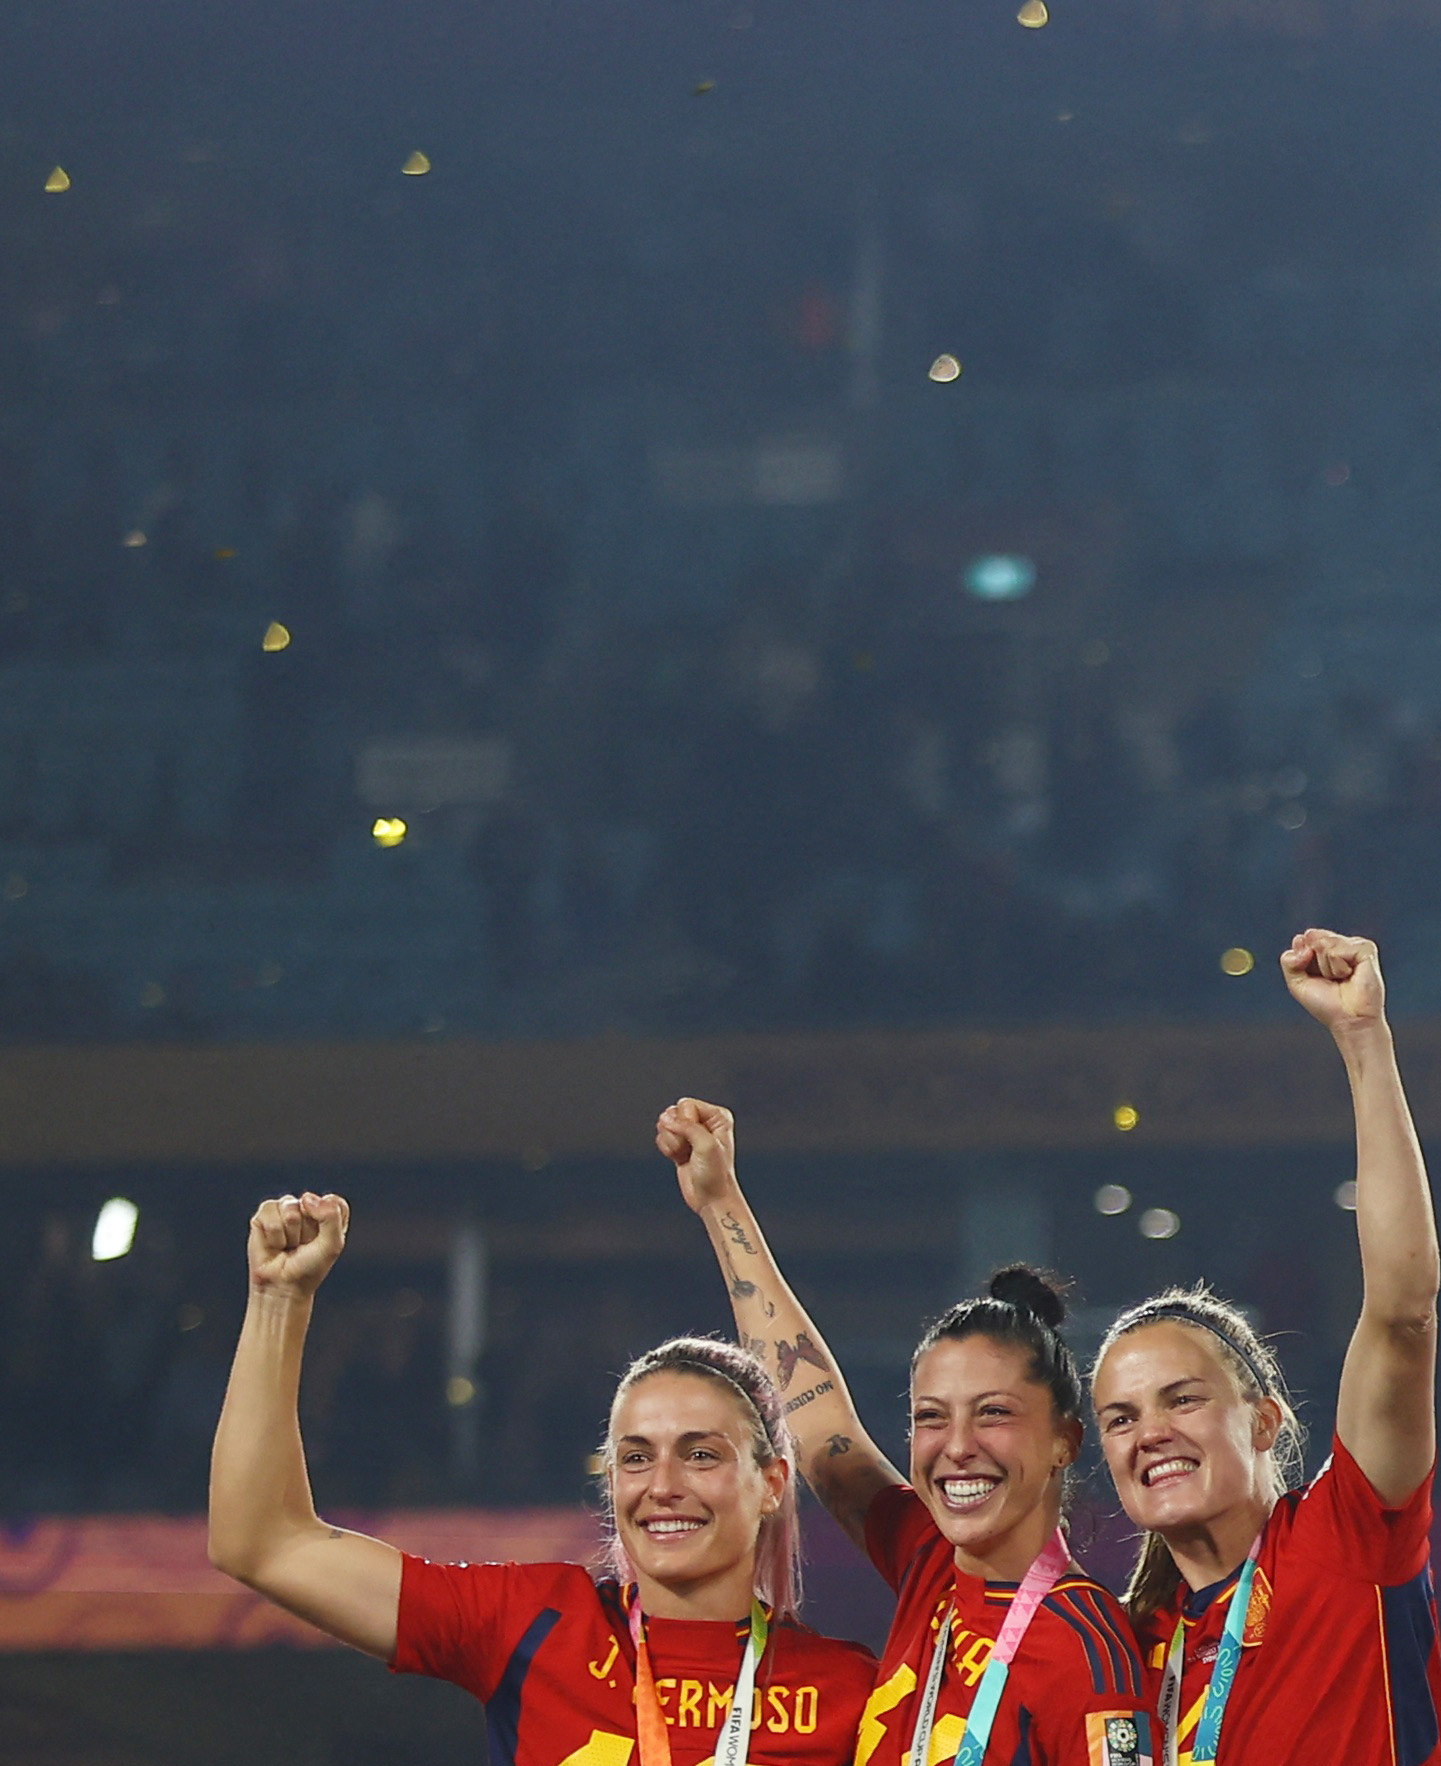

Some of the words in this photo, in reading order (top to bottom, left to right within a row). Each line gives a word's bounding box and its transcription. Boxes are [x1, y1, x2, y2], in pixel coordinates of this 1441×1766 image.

[632, 1677, 819, 1734] ERMOSO
[730, 1707, 742, 1734] FIFA
[916, 1730, 928, 1758] CUP
